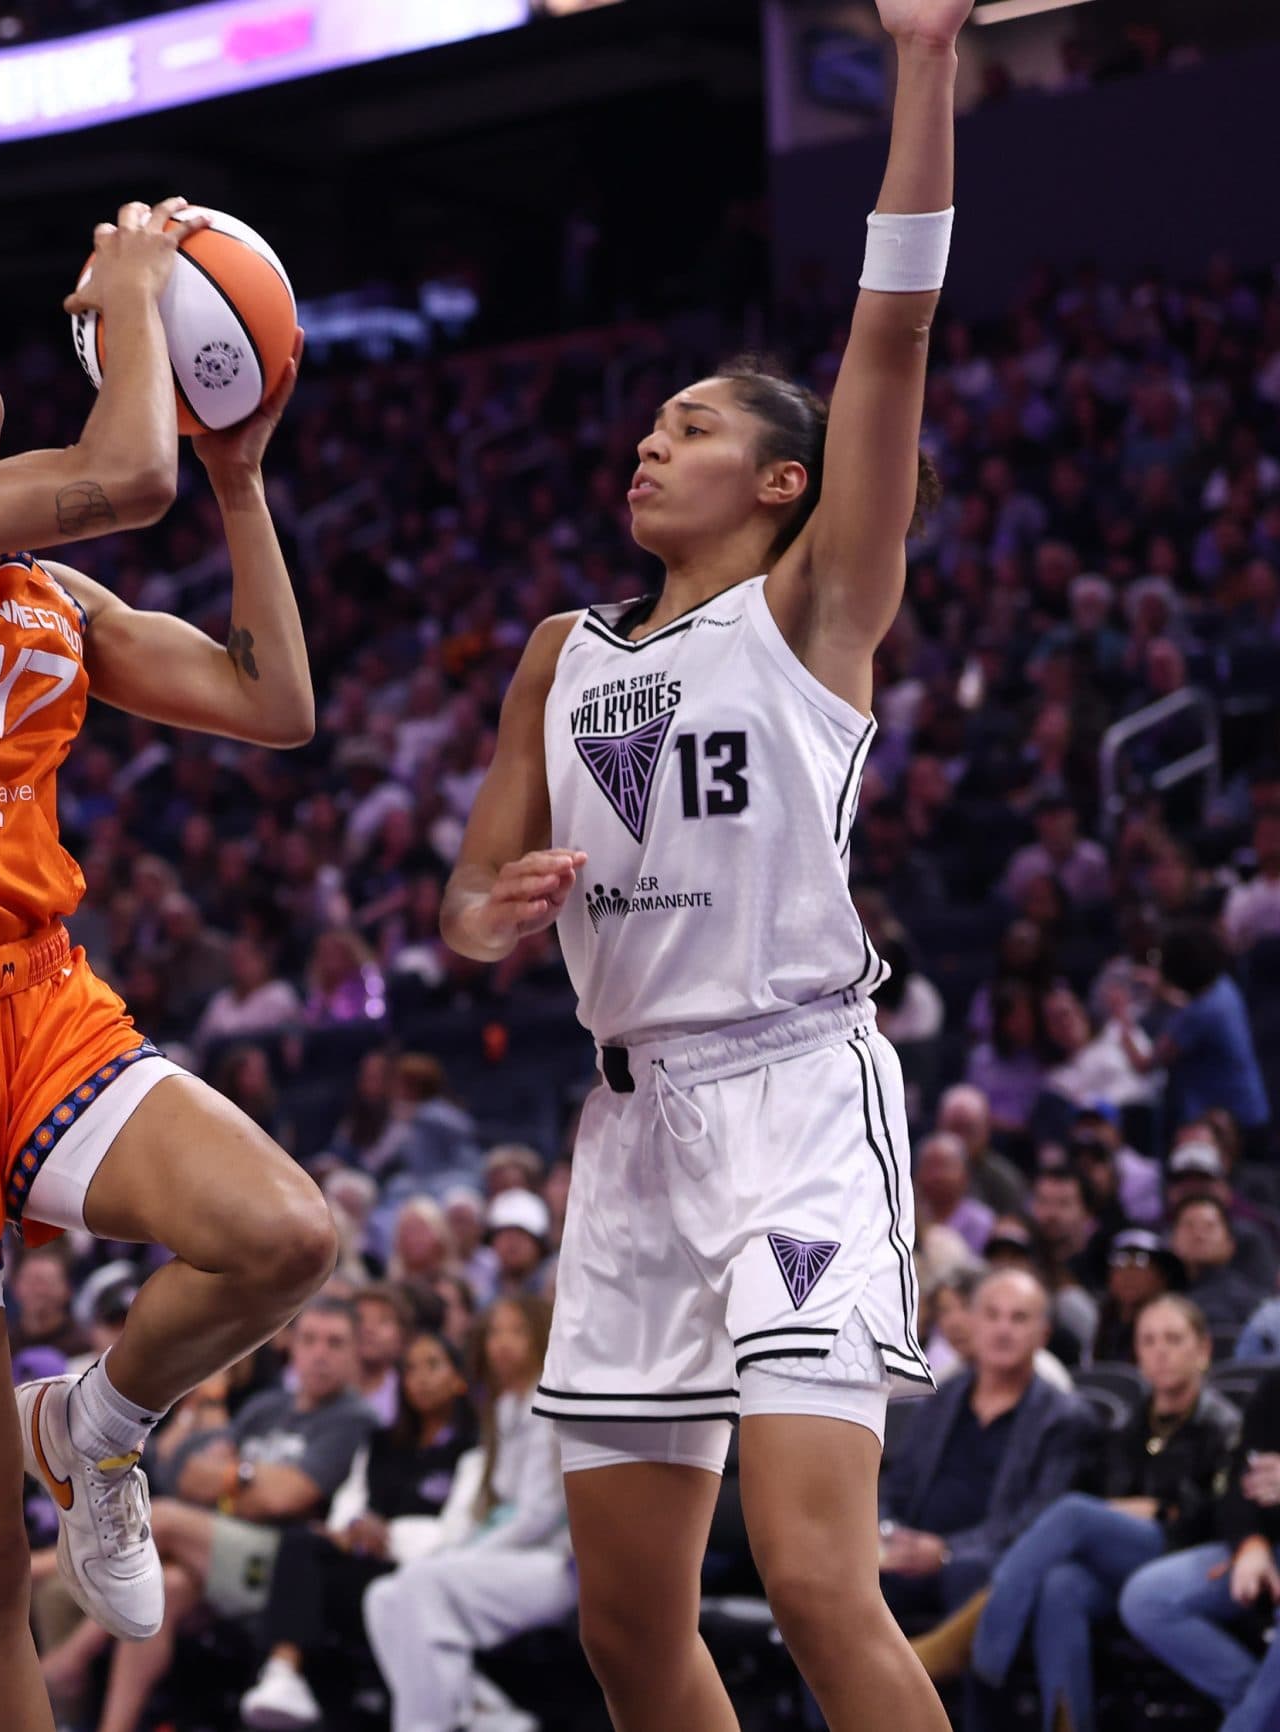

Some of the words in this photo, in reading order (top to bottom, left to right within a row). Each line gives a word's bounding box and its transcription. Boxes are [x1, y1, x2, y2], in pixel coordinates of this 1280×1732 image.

[571, 679, 682, 736] VALKYRIES
[582, 679, 626, 704] GOLDEN
[630, 670, 669, 691] STATE
[672, 729, 750, 820] 13
